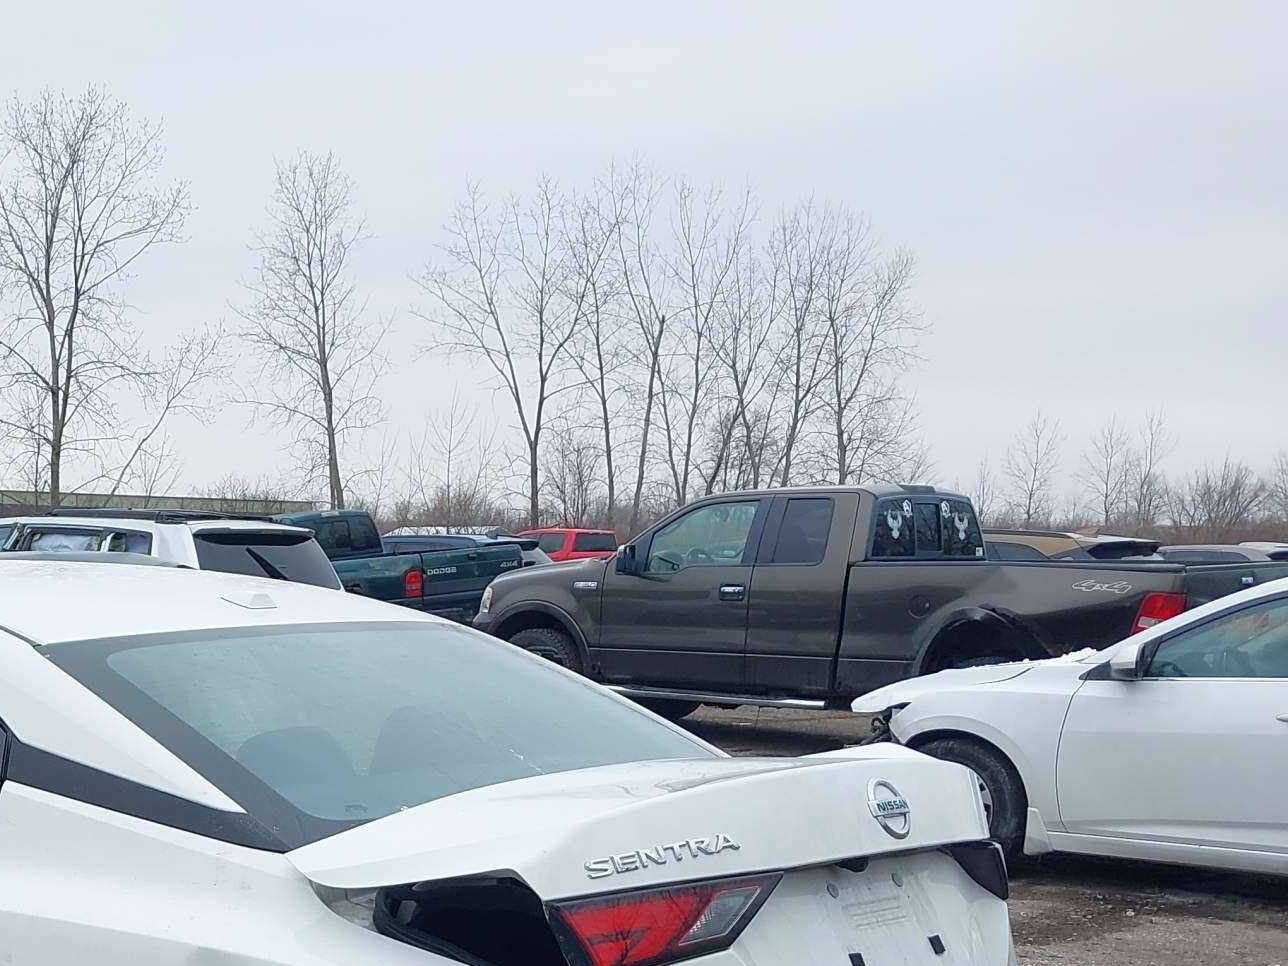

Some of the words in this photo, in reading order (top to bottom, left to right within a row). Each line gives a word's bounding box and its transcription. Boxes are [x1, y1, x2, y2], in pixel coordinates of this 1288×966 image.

[427, 566, 457, 576] DODGE
[876, 799, 910, 813] NISSAN
[584, 833, 741, 880] SENTRA
